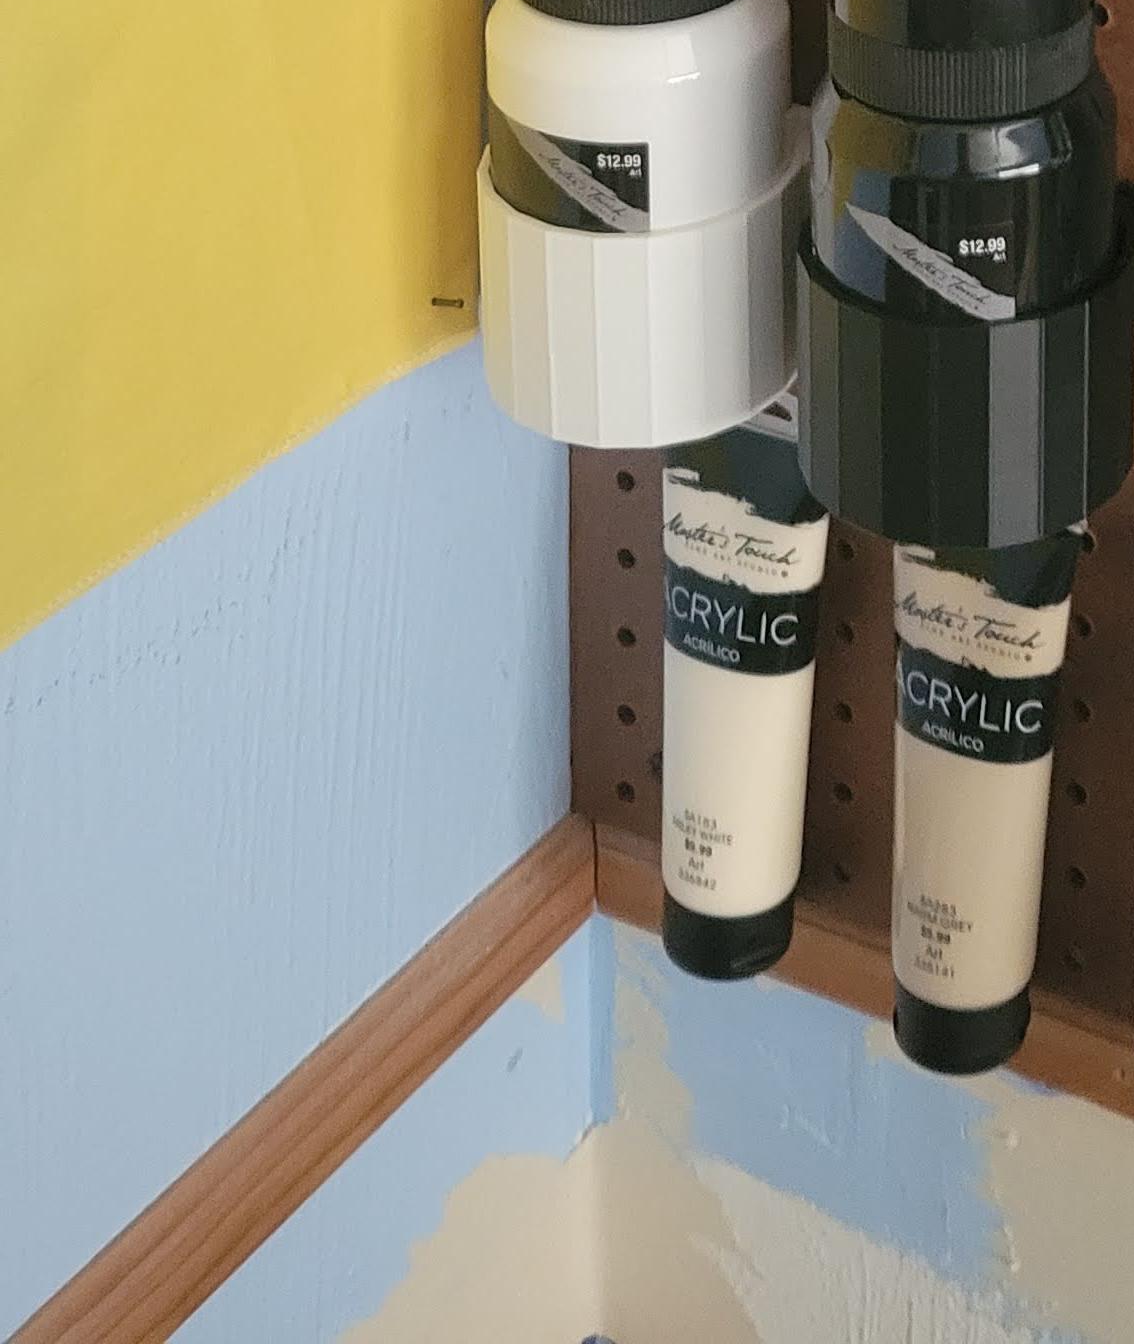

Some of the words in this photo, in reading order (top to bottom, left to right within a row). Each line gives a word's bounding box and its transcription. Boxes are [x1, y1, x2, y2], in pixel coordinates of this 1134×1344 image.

[597, 153, 642, 169] $12.99
[959, 237, 1006, 255] $12.99
[735, 532, 801, 566] Touch
[973, 615, 1043, 649] Touch
